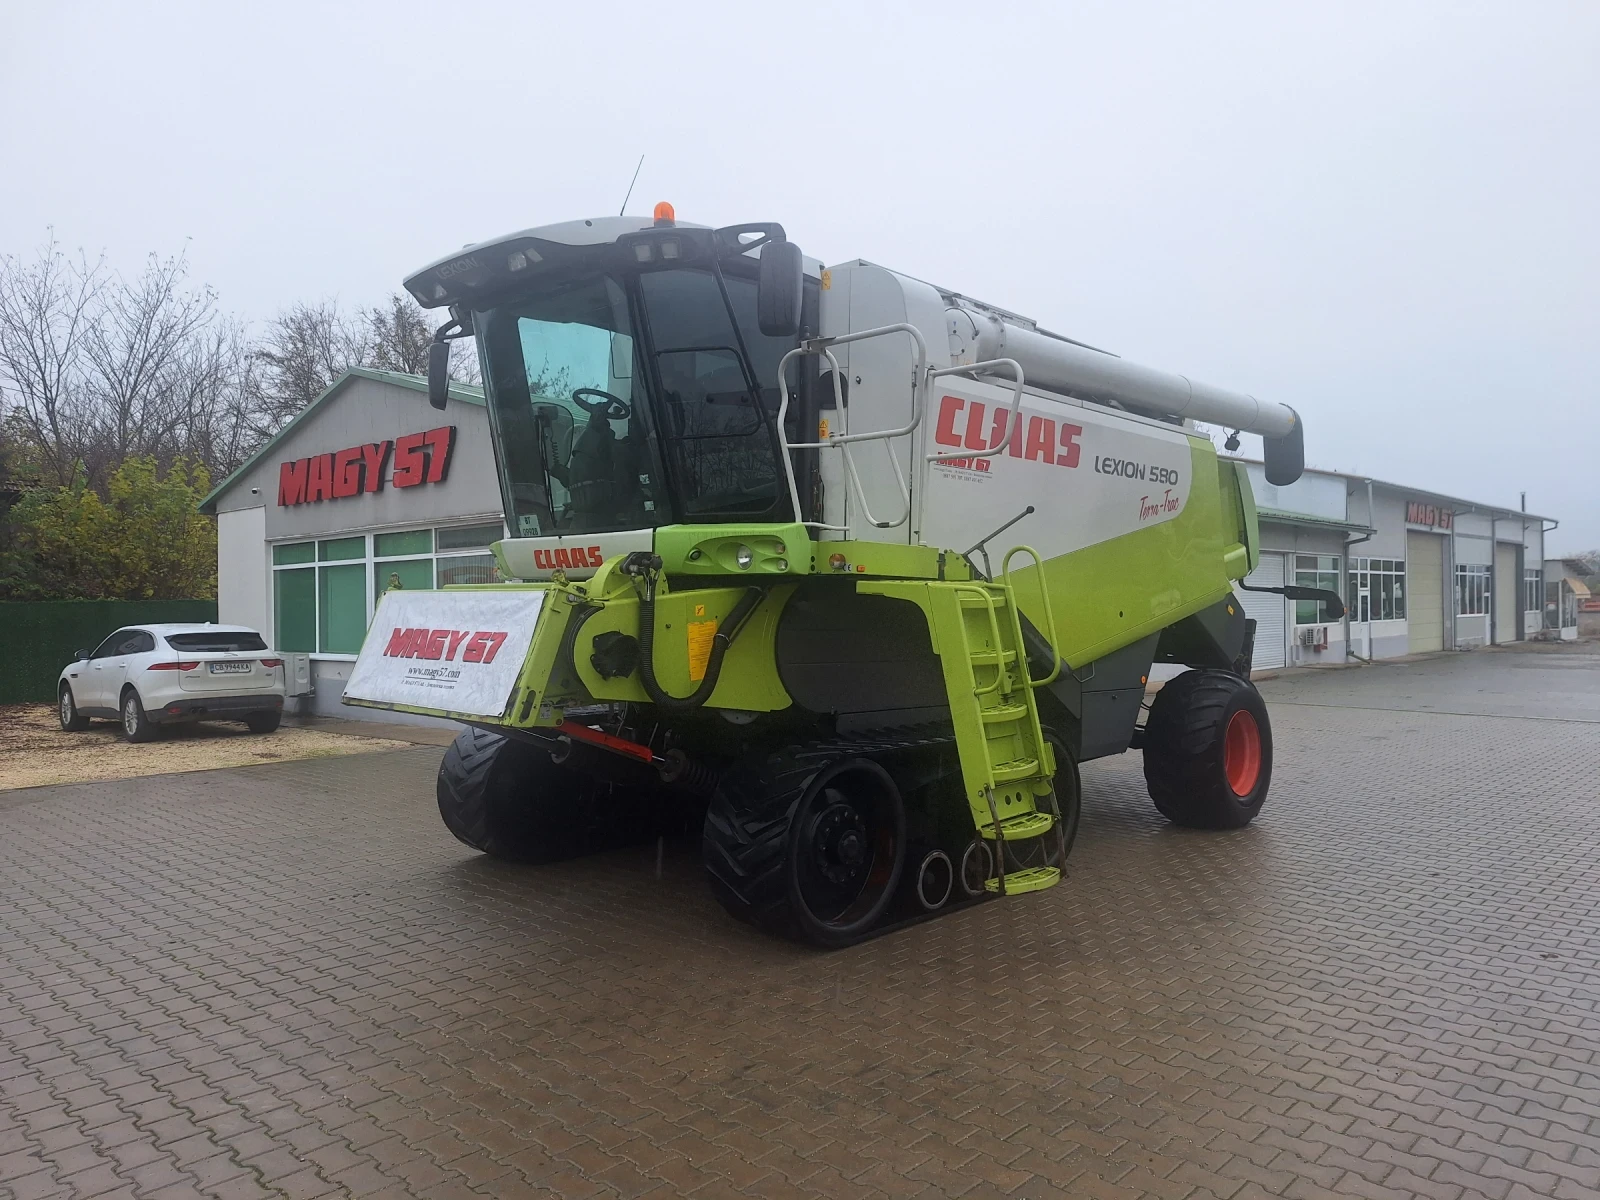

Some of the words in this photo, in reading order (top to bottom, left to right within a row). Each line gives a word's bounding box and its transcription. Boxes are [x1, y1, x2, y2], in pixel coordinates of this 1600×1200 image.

[435, 256, 479, 280] LEXION
[935, 395, 1082, 468] CLAAS
[278, 440, 392, 506] MAGY
[393, 426, 456, 489] 57
[1094, 455, 1146, 480] LEXION
[1149, 465, 1179, 486] 580
[1407, 502, 1439, 527] MAGY
[533, 546, 604, 570] CLAAS
[383, 627, 470, 662] MAGY
[463, 631, 508, 664] 57
[407, 667, 461, 680] www.magy57.com
